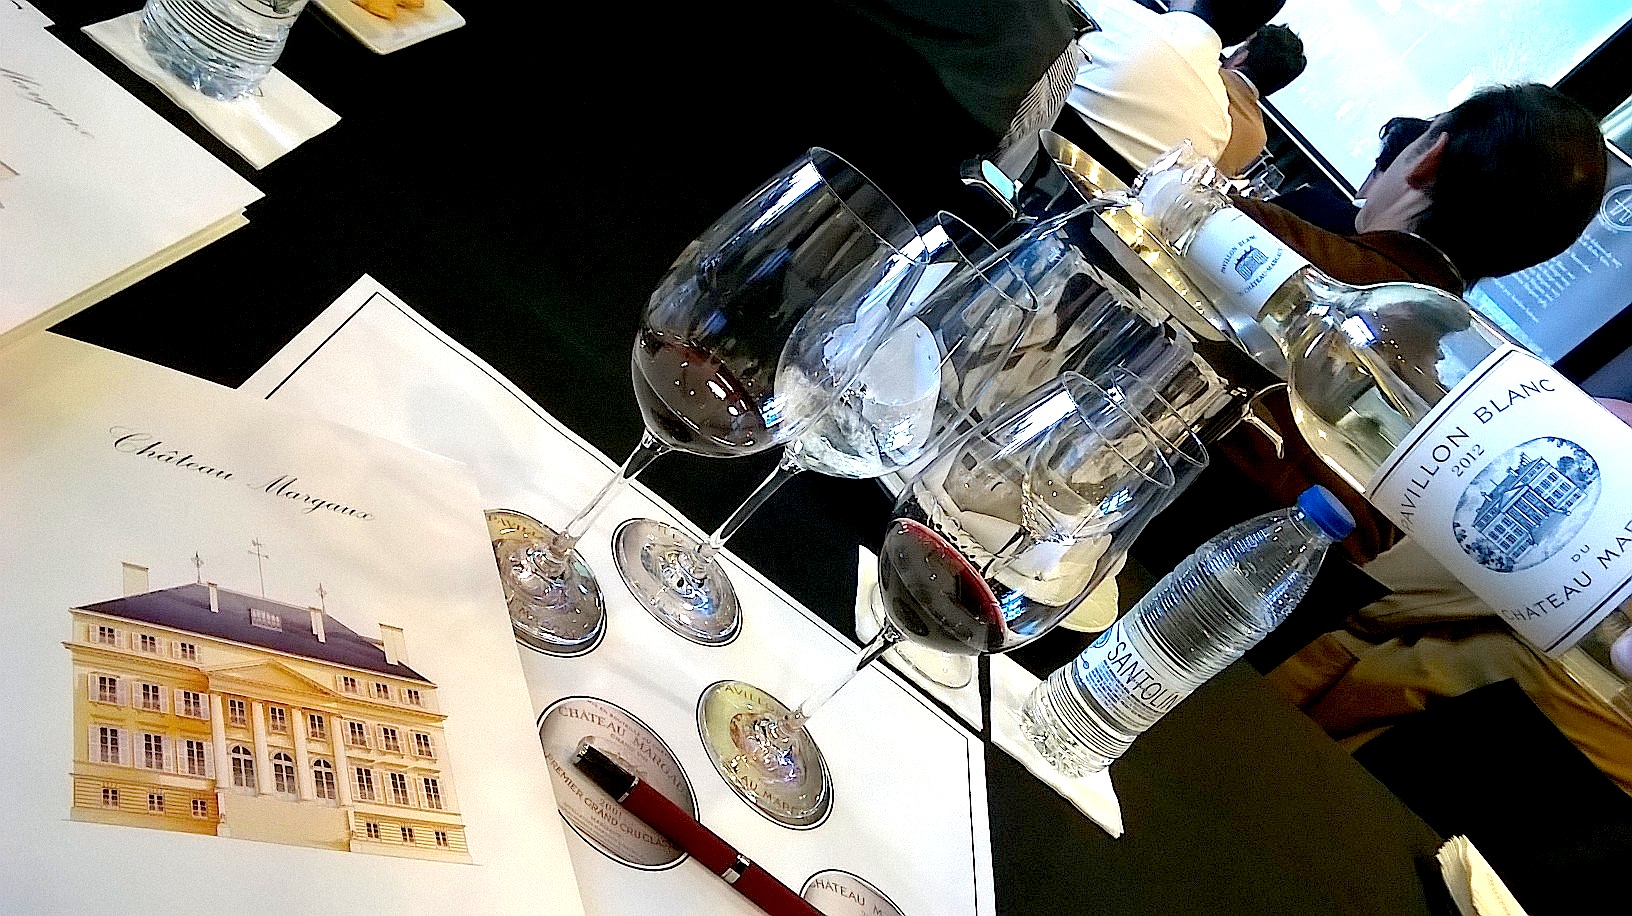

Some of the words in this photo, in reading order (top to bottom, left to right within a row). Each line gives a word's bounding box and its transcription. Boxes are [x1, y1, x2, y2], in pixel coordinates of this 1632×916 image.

[109, 426, 235, 481] Château
[247, 474, 375, 521] Margaux
[1400, 426, 1469, 534] PAVILLON
[1473, 378, 1556, 425] BLANC
[1451, 443, 1485, 478] 2012
[1570, 543, 1590, 563] DU
[1500, 570, 1592, 621] CHATEAU
[584, 797, 618, 826] GRAND
[620, 823, 641, 840] CRU
